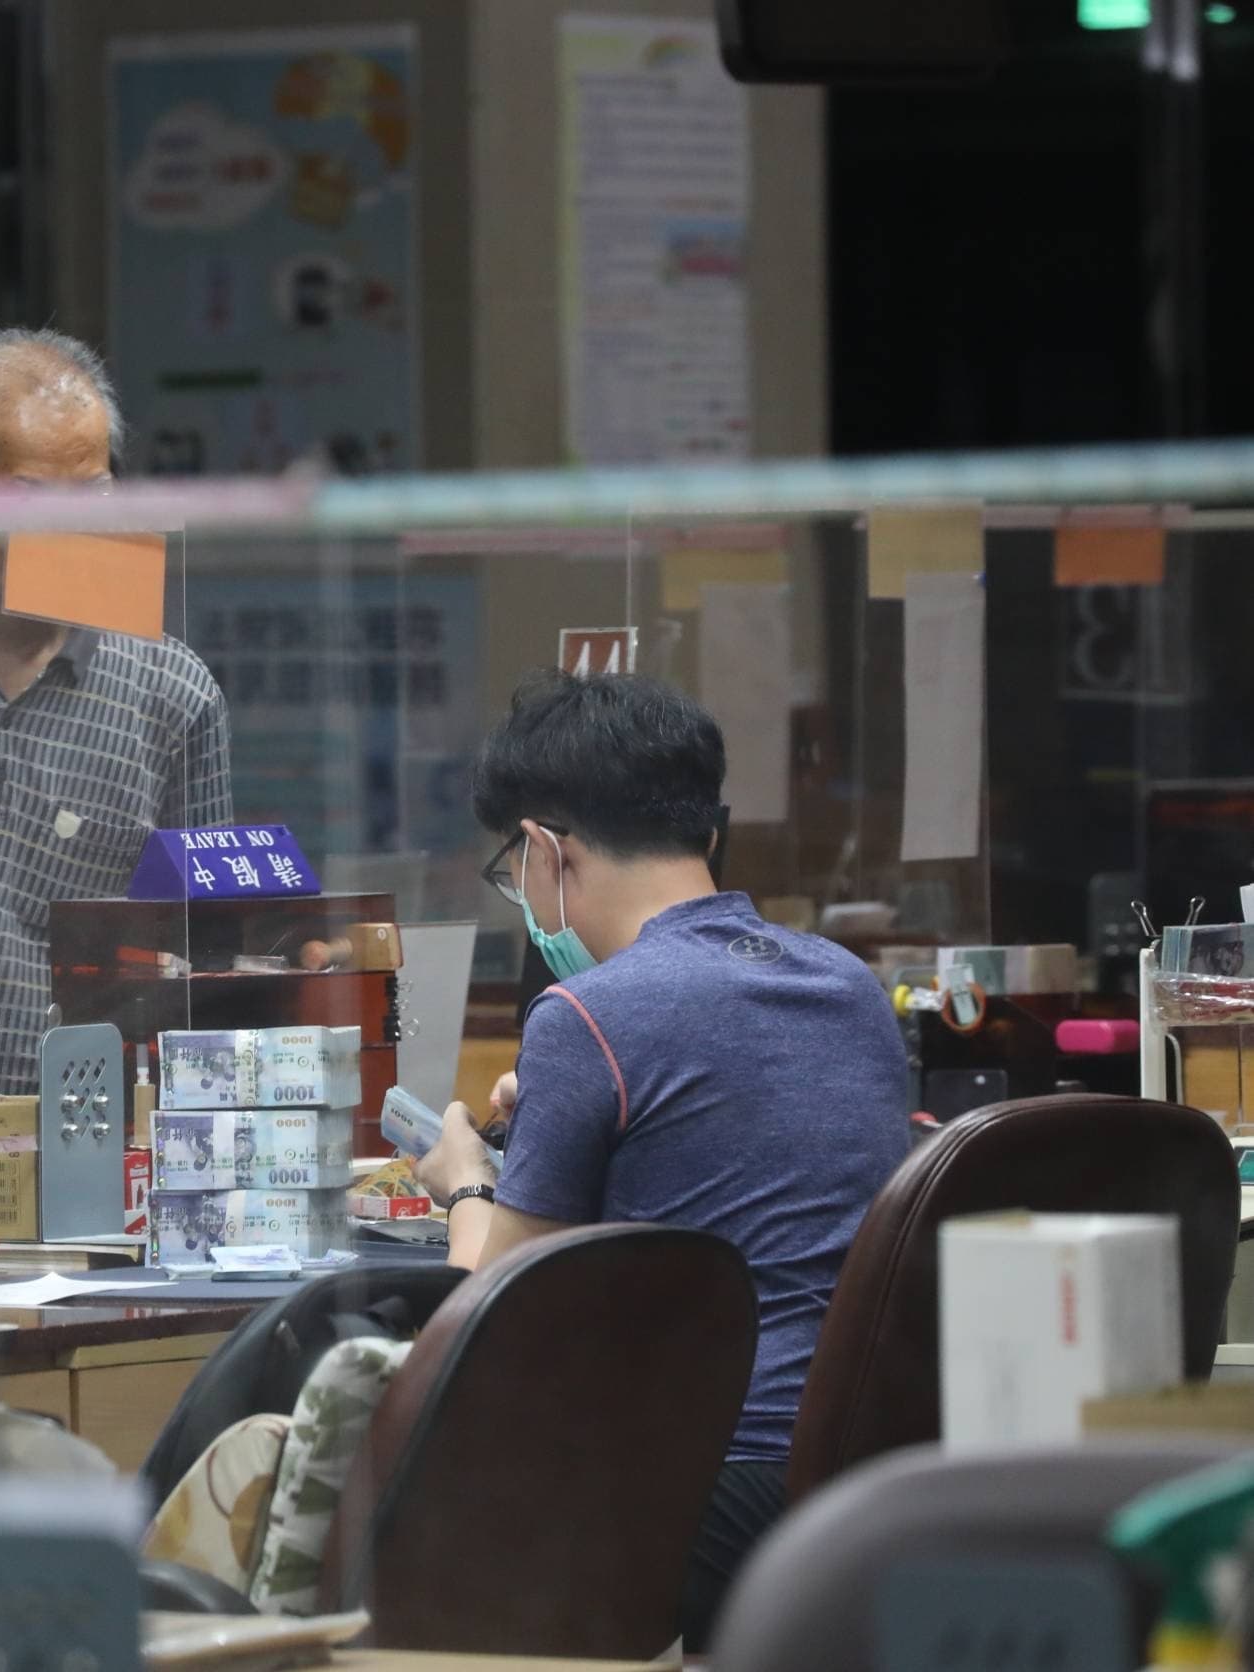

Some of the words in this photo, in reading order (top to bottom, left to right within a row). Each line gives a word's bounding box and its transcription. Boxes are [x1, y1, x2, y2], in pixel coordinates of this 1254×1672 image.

[180, 831, 242, 849] LEAVE
[248, 830, 274, 847] ON
[193, 853, 302, 890] 請假中
[274, 1086, 316, 1102] 1000
[276, 1118, 307, 1128] 1000
[268, 1168, 311, 1185] 1000
